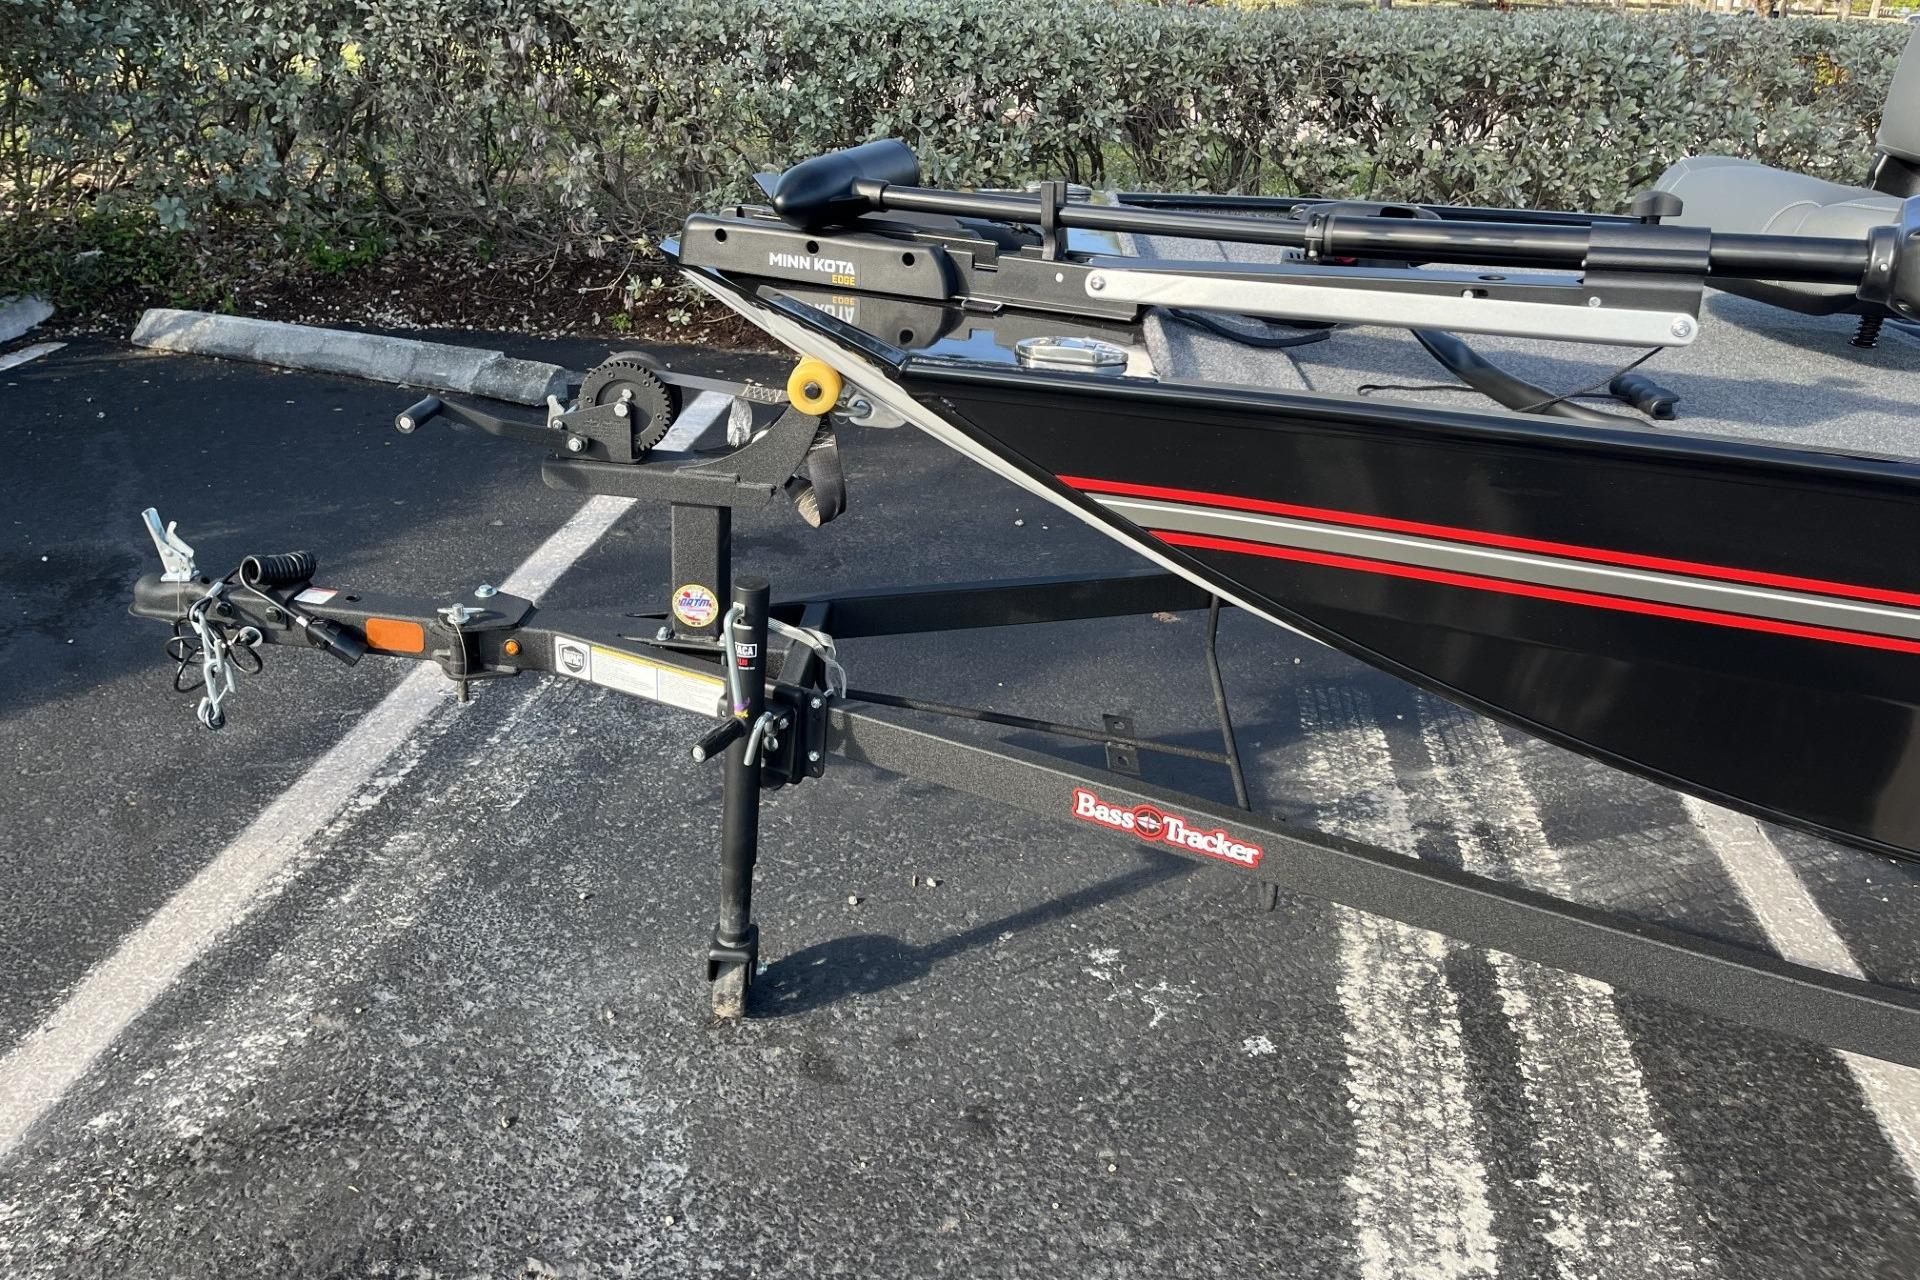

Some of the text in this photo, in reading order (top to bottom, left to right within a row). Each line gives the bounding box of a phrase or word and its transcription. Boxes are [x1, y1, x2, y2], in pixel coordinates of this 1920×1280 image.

[769, 252, 855, 276] MINN KOTA
[831, 274, 856, 286] EDGE
[1075, 791, 1260, 864] Bass Tracker
